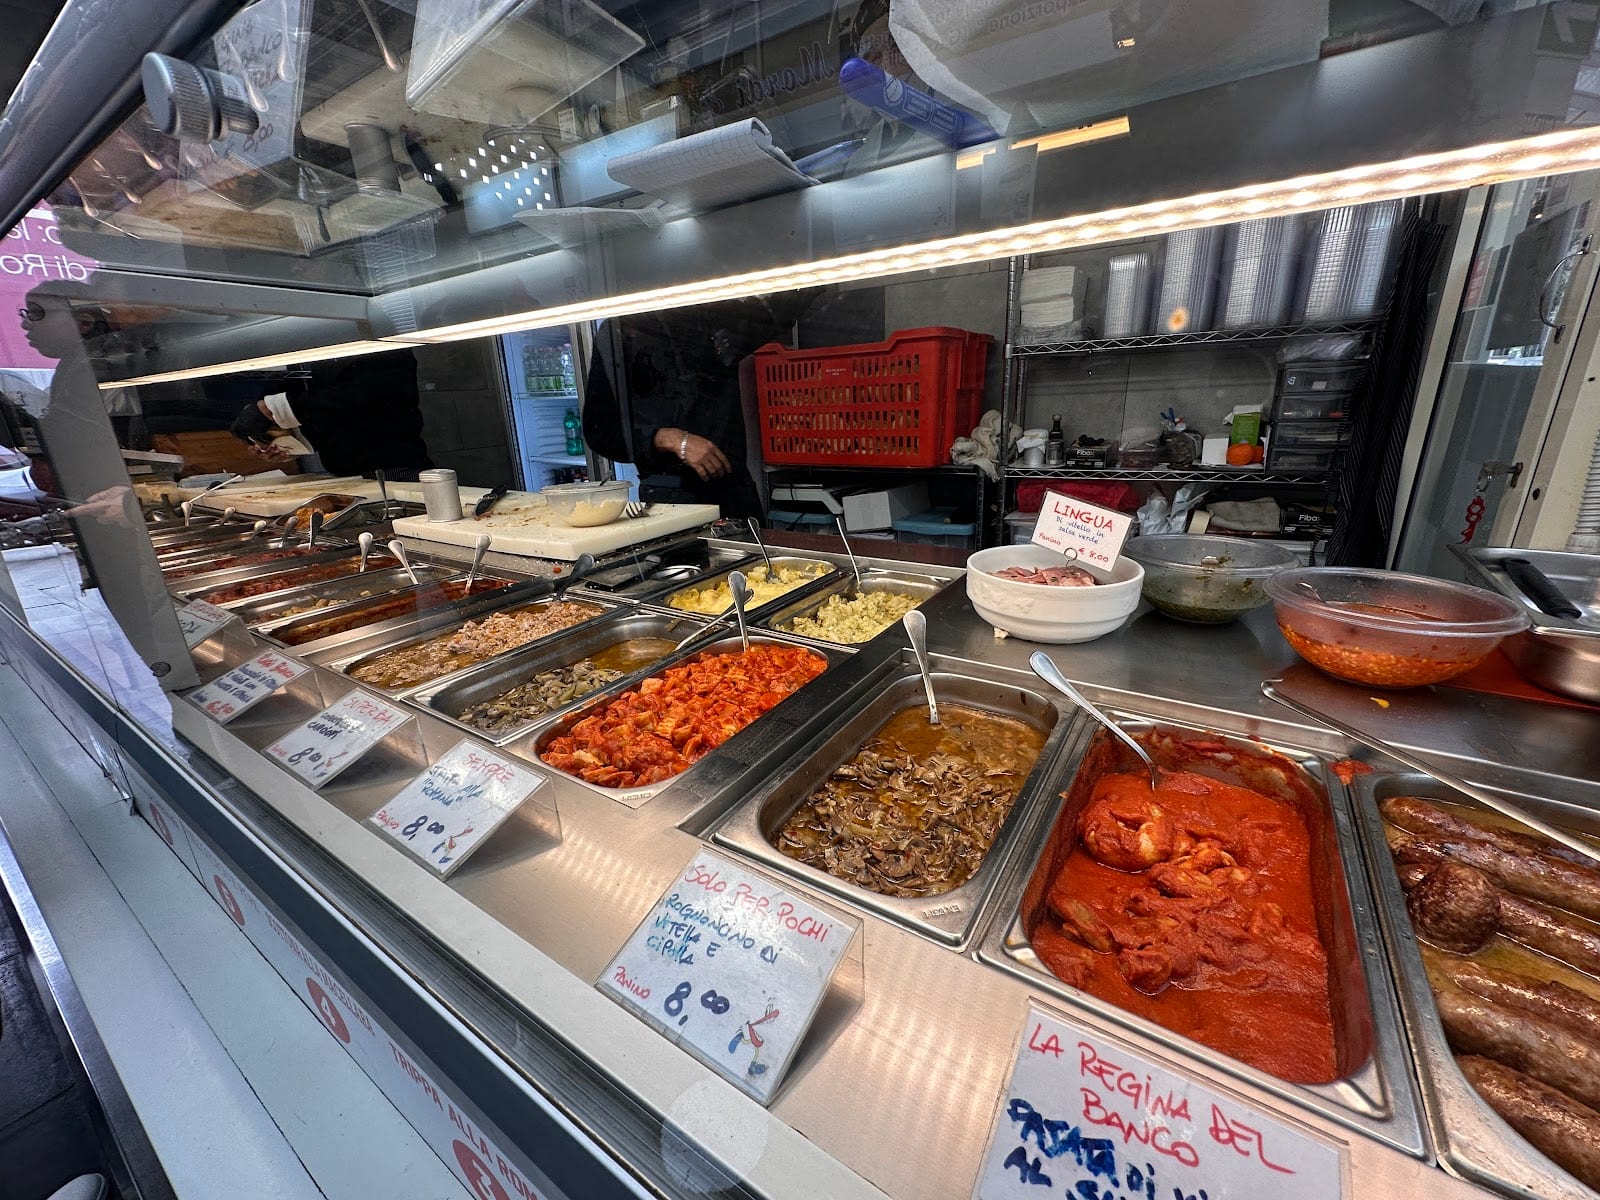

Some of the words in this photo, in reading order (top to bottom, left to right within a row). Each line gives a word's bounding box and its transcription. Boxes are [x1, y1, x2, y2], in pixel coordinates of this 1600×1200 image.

[1054, 501, 1113, 532] LINGUA
[1068, 521, 1091, 533] vitello
[1078, 534, 1099, 544] verde
[1089, 550, 1109, 563] 8.00
[402, 815, 445, 841] 8,00
[731, 883, 770, 915] PER
[706, 942, 721, 957] E
[320, 996, 337, 1027] 4
[663, 981, 730, 1026] 8,00
[388, 1041, 444, 1111] TRIPPA
[448, 1104, 493, 1164] ALLA
[1029, 1023, 1064, 1058] LA
[1208, 1103, 1297, 1175] DEL
[1079, 1087, 1200, 1168] BANCO
